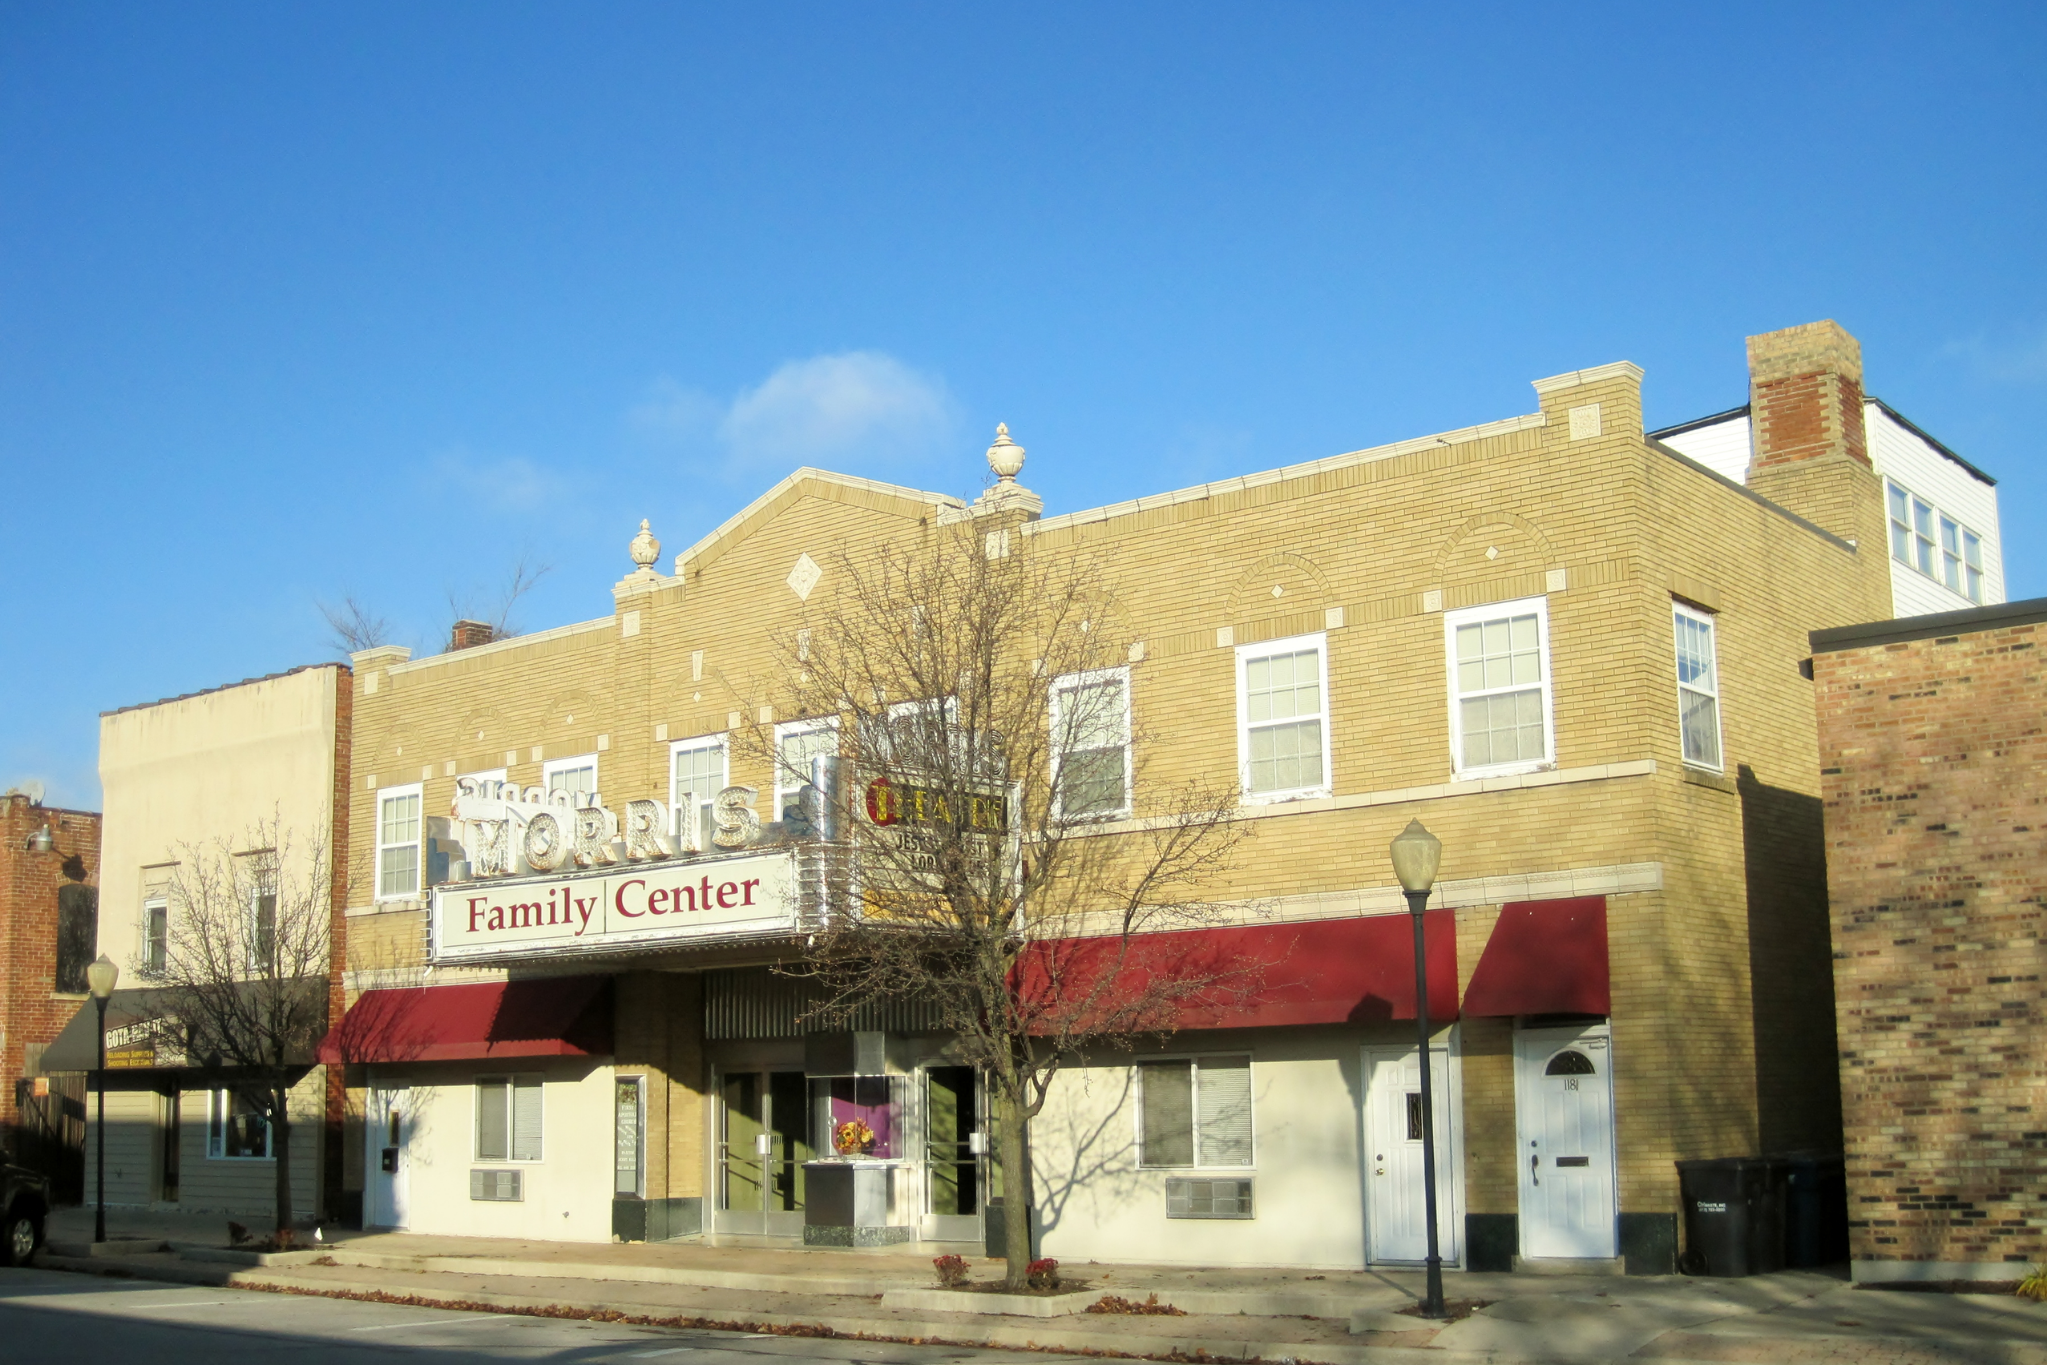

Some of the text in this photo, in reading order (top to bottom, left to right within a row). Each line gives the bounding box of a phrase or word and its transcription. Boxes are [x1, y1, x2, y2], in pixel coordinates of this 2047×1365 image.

[857, 709, 1007, 781] MORIS
[470, 785, 762, 878] MORRIS
[870, 784, 1004, 830] THEARE
[466, 875, 760, 936] Family Center
[1564, 1079, 1579, 1091] 1181
